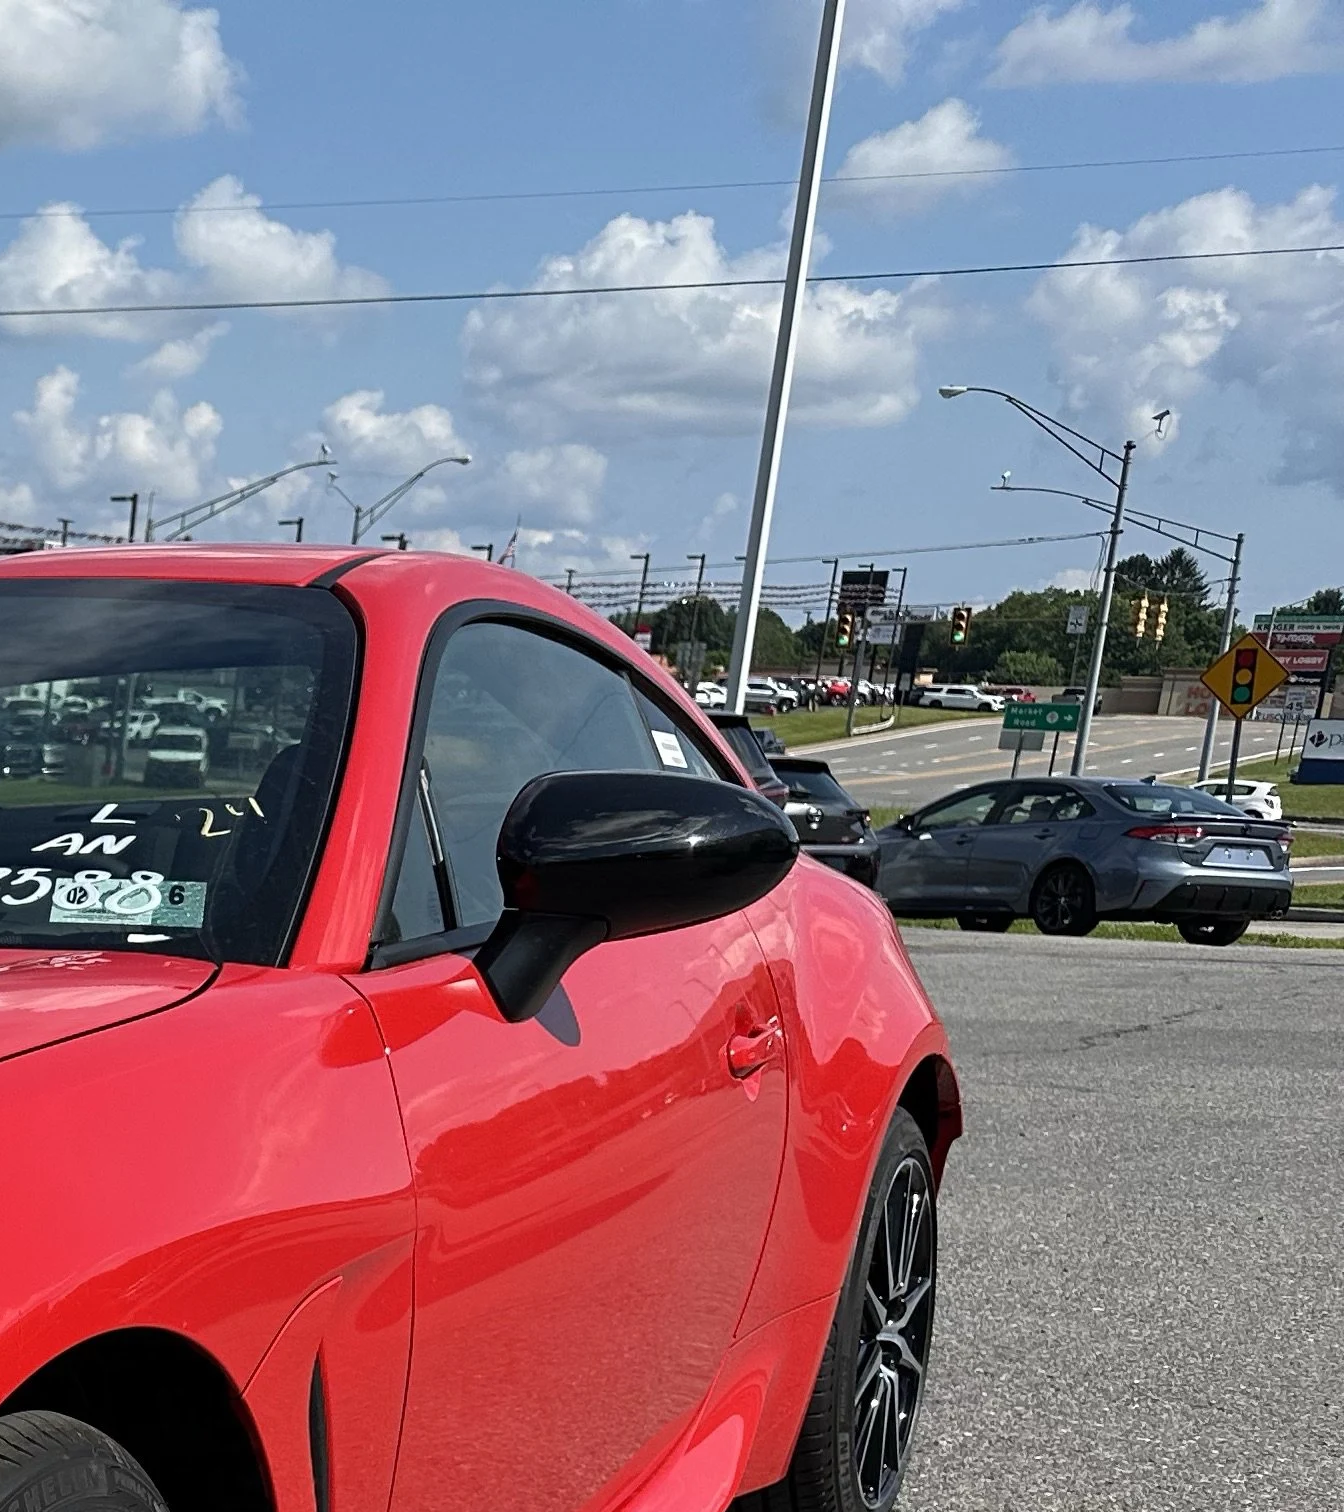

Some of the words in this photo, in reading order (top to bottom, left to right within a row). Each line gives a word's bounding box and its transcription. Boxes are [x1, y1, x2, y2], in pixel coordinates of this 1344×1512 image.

[1010, 707, 1043, 715] Market
[1286, 702, 1303, 711] 45
[1013, 718, 1036, 727] Road
[90, 803, 136, 824] L
[30, 832, 136, 855] AN
[168, 884, 186, 905] 6
